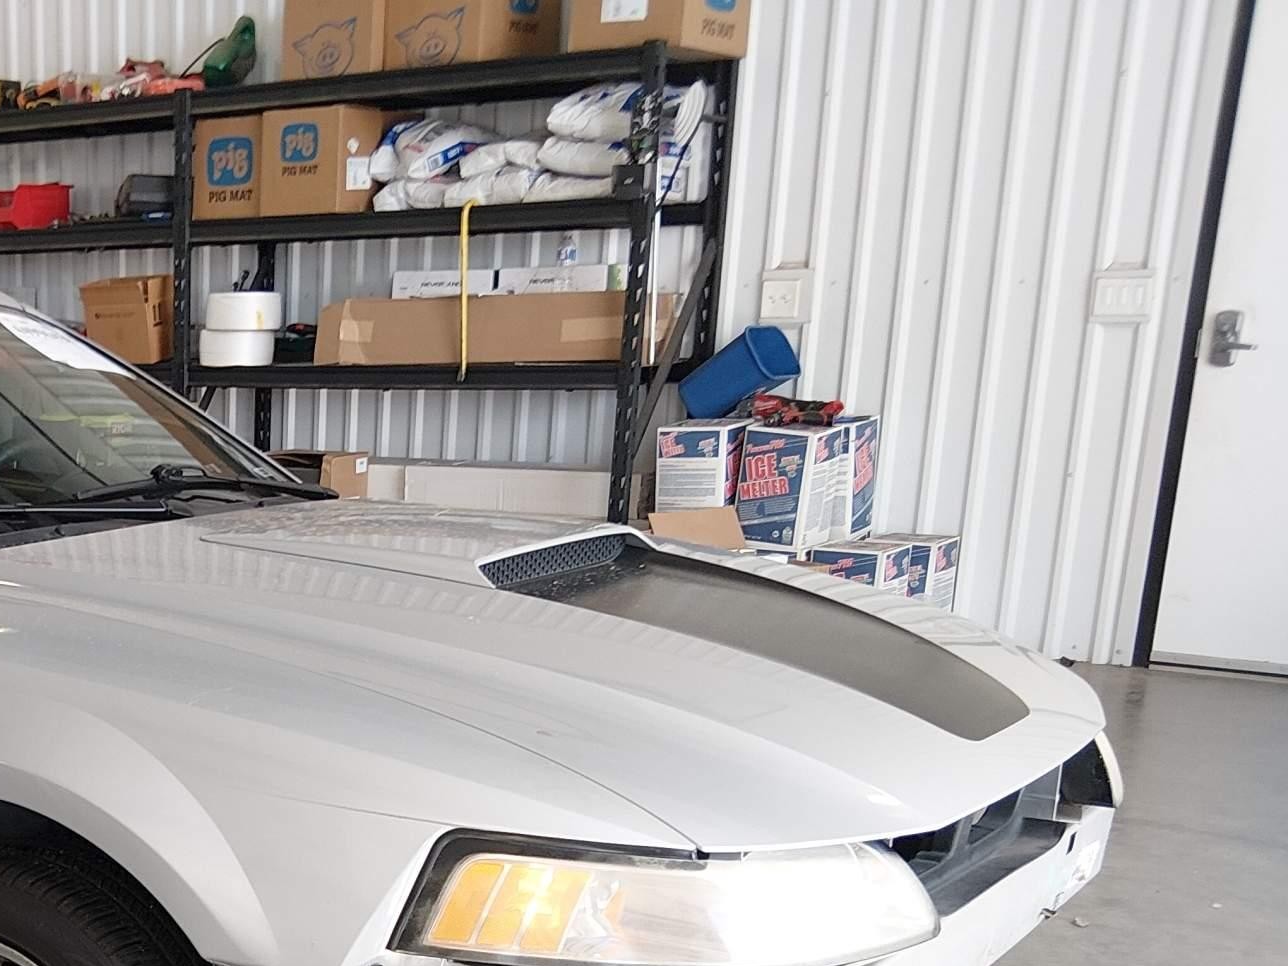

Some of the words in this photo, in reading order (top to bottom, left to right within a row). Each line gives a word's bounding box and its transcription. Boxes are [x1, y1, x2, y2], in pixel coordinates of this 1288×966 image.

[285, 126, 316, 159] pig
[213, 141, 249, 181] pig
[282, 166, 297, 176] PIG
[298, 165, 318, 176] MAT
[208, 191, 227, 203] PIG
[230, 189, 253, 201] MAT
[745, 453, 778, 483] ICE
[739, 476, 789, 501] MELTER
